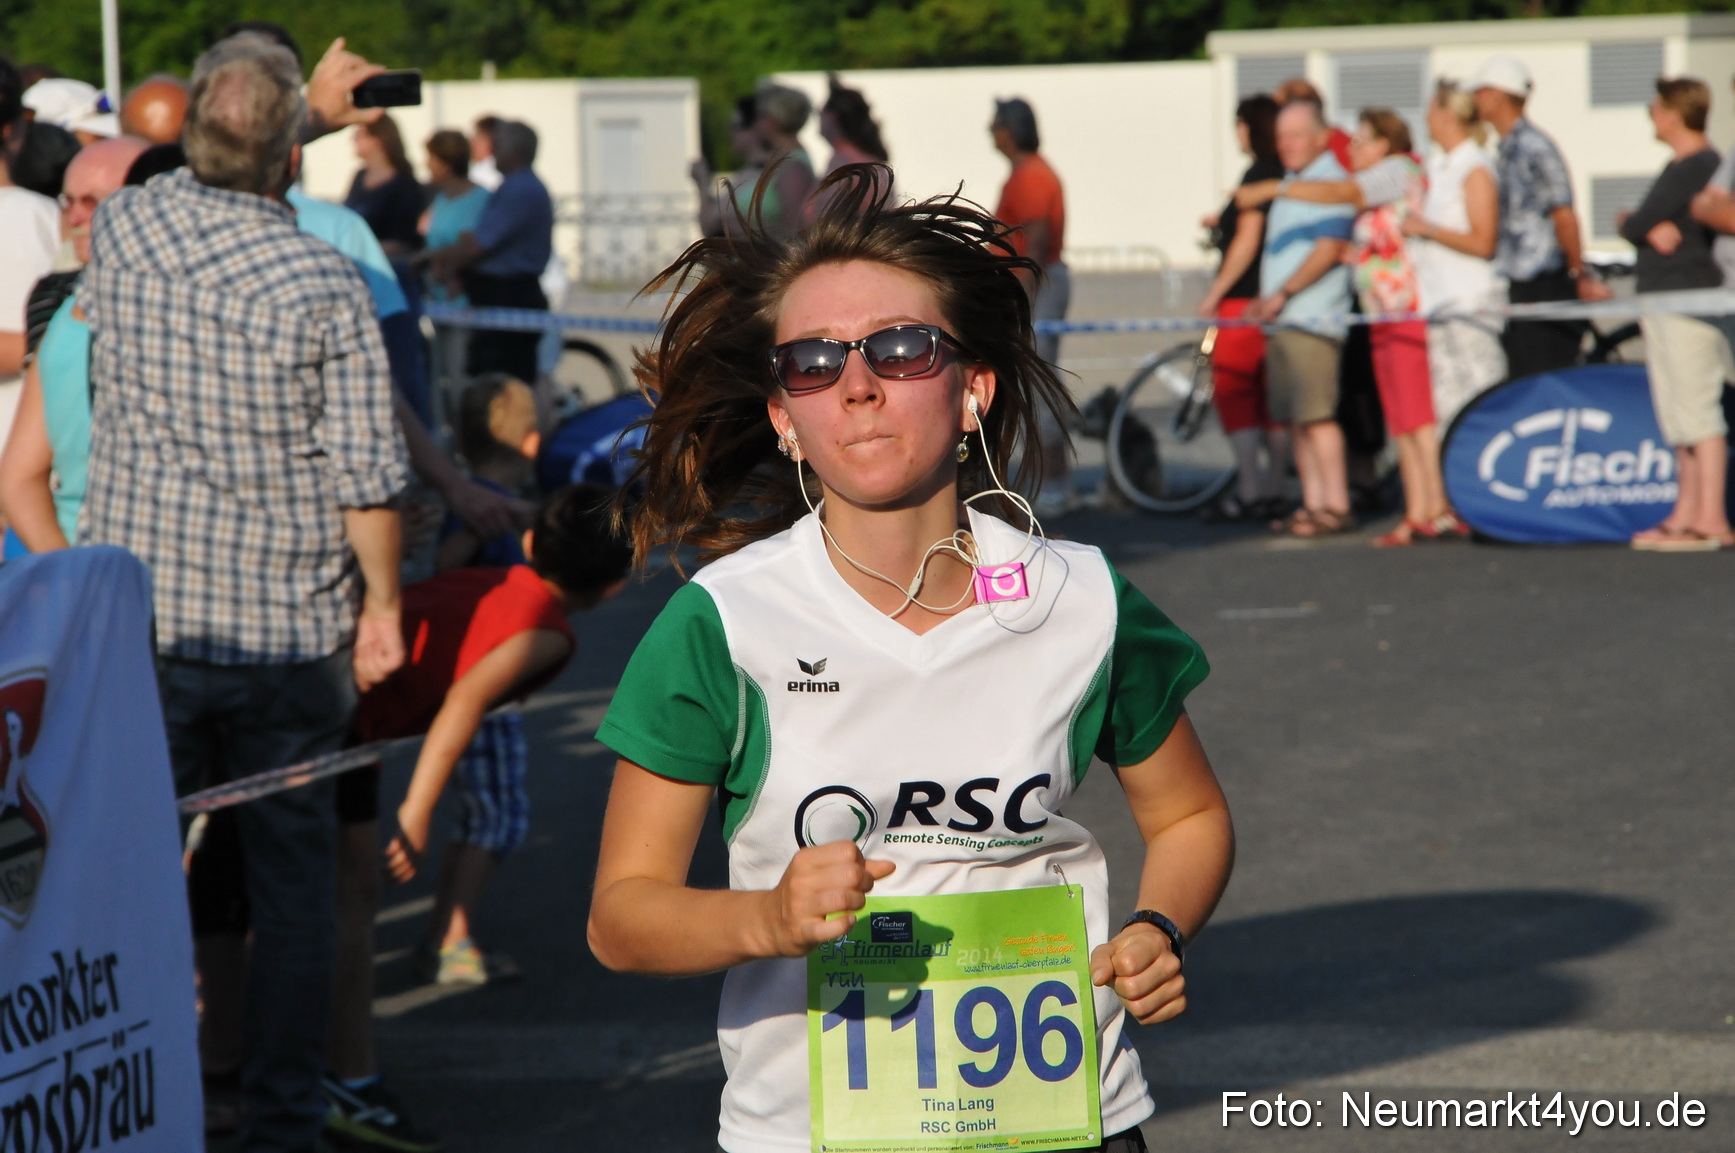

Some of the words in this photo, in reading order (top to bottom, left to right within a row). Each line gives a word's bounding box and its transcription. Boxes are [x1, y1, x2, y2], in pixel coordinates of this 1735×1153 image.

[1525, 433, 1679, 489] Fisch
[787, 679, 840, 693] erima
[887, 773, 1051, 834] RSC
[883, 832, 934, 844] Remote
[936, 833, 985, 852] Sensing
[987, 835, 1044, 849] Concepts
[878, 919, 907, 928] Fischer
[853, 938, 952, 957] firmenlauf
[956, 947, 1004, 966] 2014
[822, 980, 1084, 1091] 1196
[922, 1098, 955, 1112] Tina
[958, 1098, 995, 1113] Lang
[920, 1120, 951, 1134] RSC
[955, 1118, 996, 1134] GmbH
